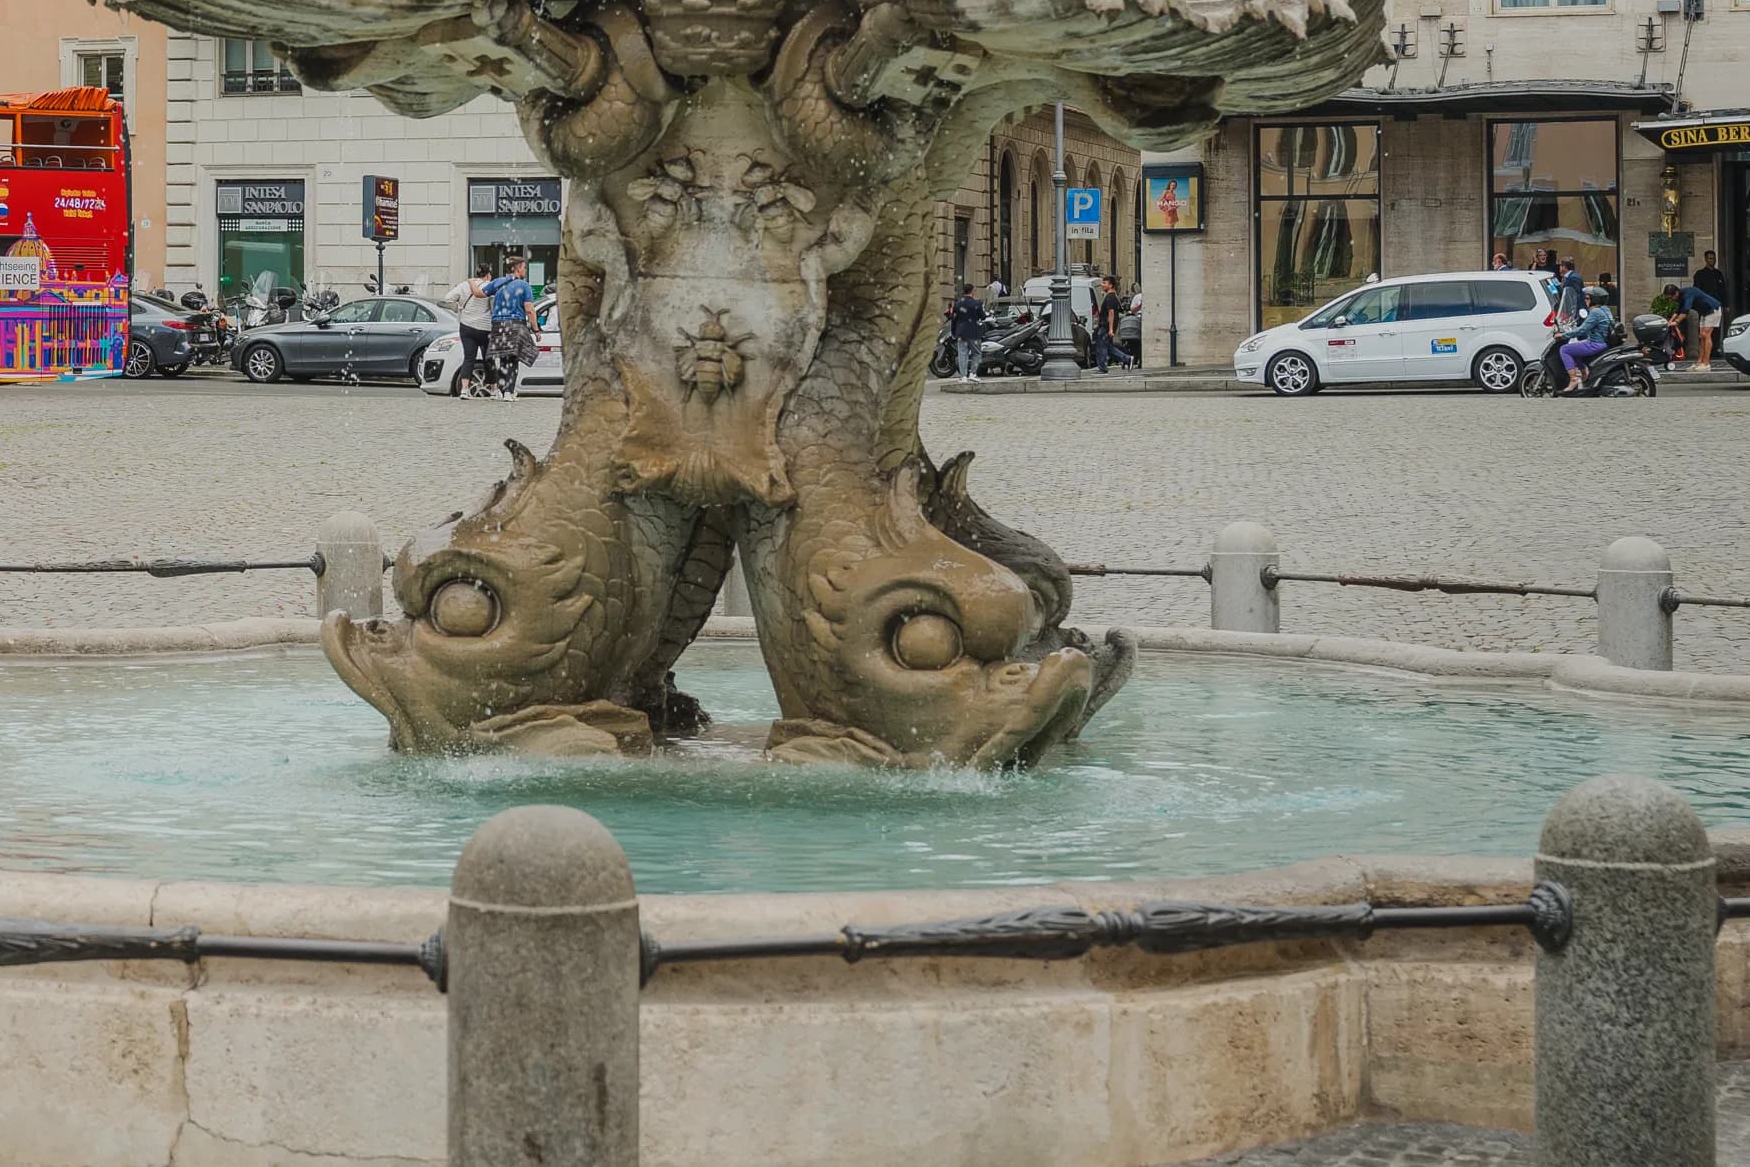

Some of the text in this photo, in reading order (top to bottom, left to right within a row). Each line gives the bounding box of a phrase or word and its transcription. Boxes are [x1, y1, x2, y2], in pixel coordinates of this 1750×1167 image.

[1670, 125, 1750, 146] SINA BER
[244, 186, 287, 199] INTESA
[497, 184, 542, 198] INTESA
[54, 197, 106, 210] 24/48/72
[243, 201, 304, 214] SANPAOLO
[497, 200, 561, 214] SANPAOLO
[1073, 192, 1094, 219] P
[1071, 226, 1095, 234] in fila
